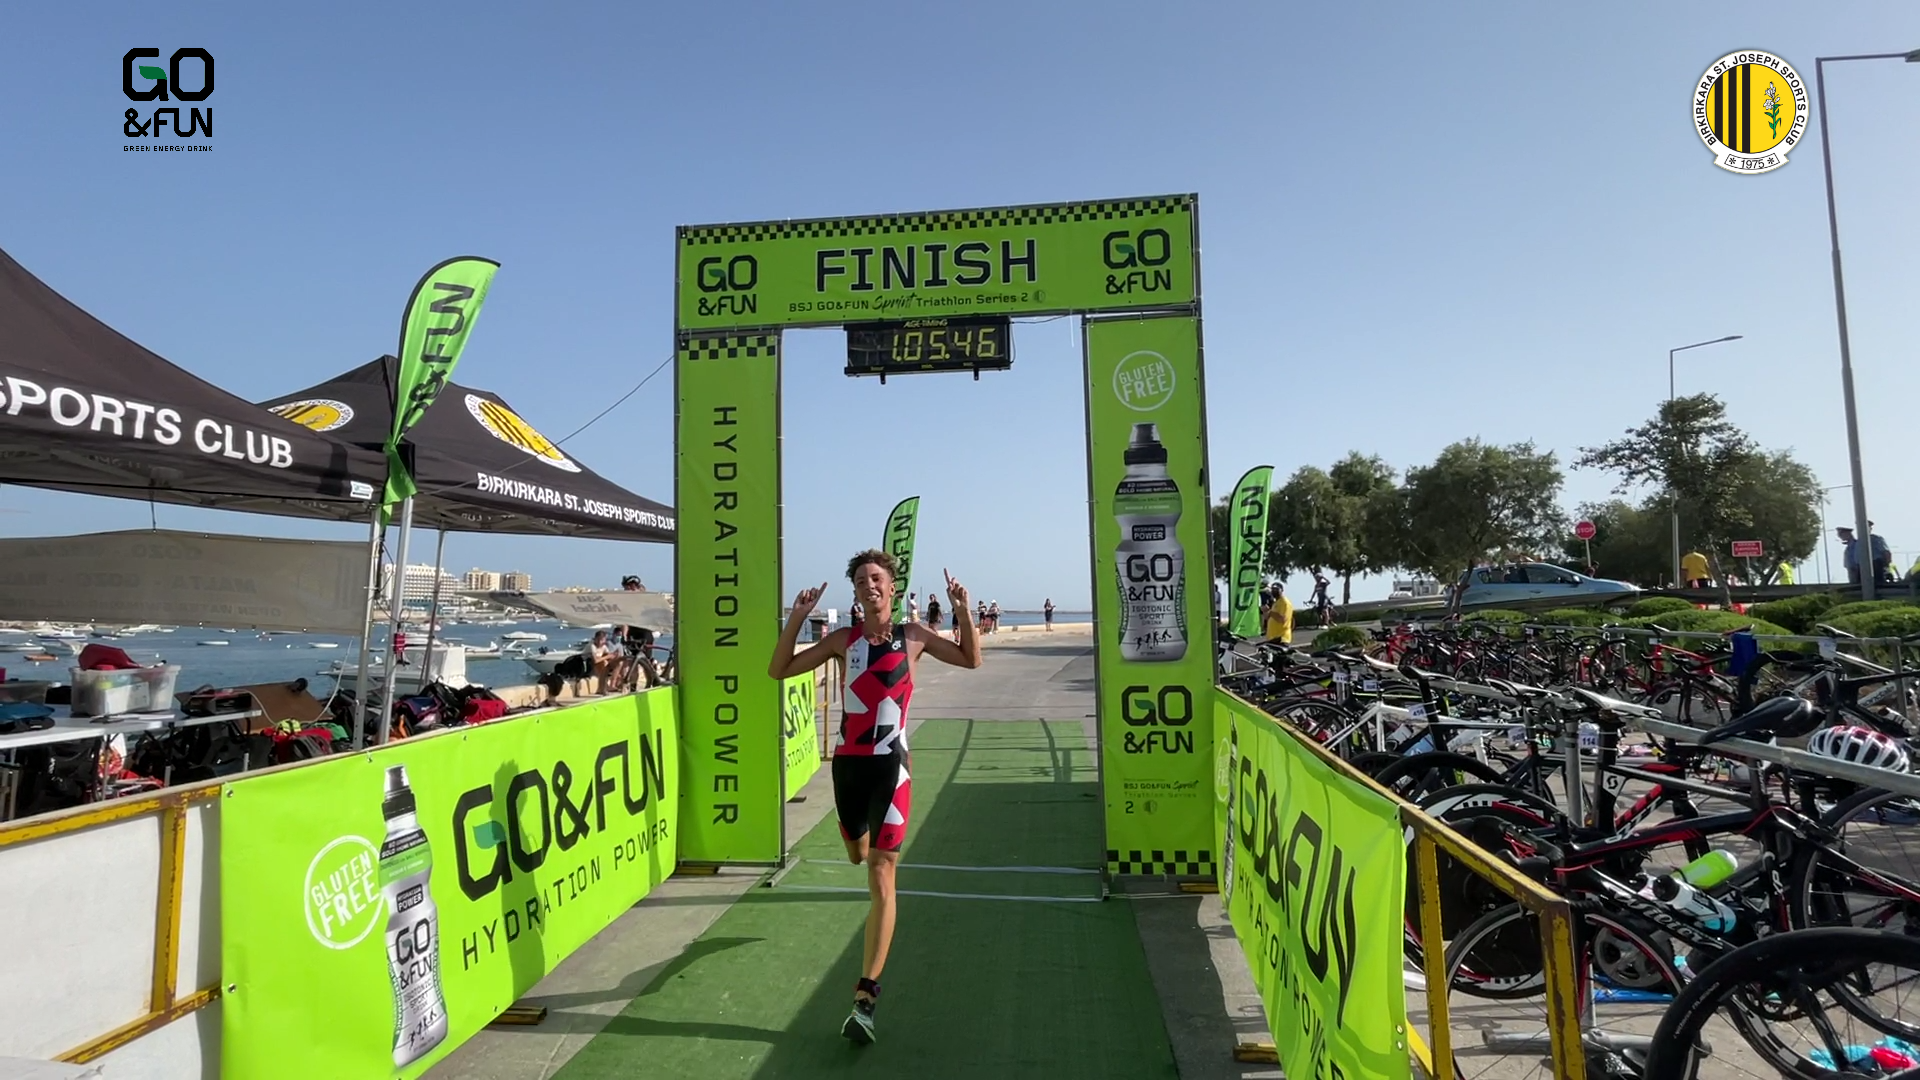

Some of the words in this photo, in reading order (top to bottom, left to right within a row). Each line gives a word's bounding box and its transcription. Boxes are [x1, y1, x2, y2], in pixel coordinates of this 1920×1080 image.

[1103, 228, 1171, 270] GO
[697, 255, 758, 293] GO
[815, 238, 1037, 293] FINISH
[1105, 269, 1172, 295] &FUN
[698, 293, 757, 316] &FUN
[789, 302, 812, 312] BSJ
[817, 300, 869, 311] GO&FUN
[872, 292, 917, 313] Sprint
[917, 295, 971, 307] Triathlon
[976, 293, 1017, 304] Series
[1021, 292, 1028, 302] 2
[1118, 361, 1165, 385] GLUTEN
[1122, 374, 1171, 402] FREE
[194, 419, 294, 469] CLUB
[477, 472, 563, 507] BIRKIRKARA
[564, 493, 582, 512] ST.
[583, 499, 623, 521] JOSEPH
[623, 507, 657, 528] SPORTS
[713, 406, 739, 647] HYDRATION
[1133, 532, 1164, 540] POWER
[1576, 526, 1595, 534] STOP
[1126, 553, 1174, 583] GO
[1128, 585, 1174, 601] &FUN
[1131, 605, 1172, 613] ISOTONIC
[1121, 685, 1193, 727] GO
[712, 675, 739, 825] POWER
[1123, 730, 1194, 754] &FUN
[1581, 736, 1596, 746] 114
[1123, 782, 1138, 790] BSJ
[1140, 782, 1171, 790] GO&FUN
[452, 728, 666, 902] GO&FUN
[1125, 801, 1134, 814] 2
[311, 851, 373, 907] GLUTEN
[318, 869, 380, 938] FREE
[398, 893, 423, 912] POWER
[462, 855, 602, 971] HYDRATION
[614, 818, 669, 871] POWER
[395, 917, 431, 966] GO
[399, 953, 433, 991] &FUN
